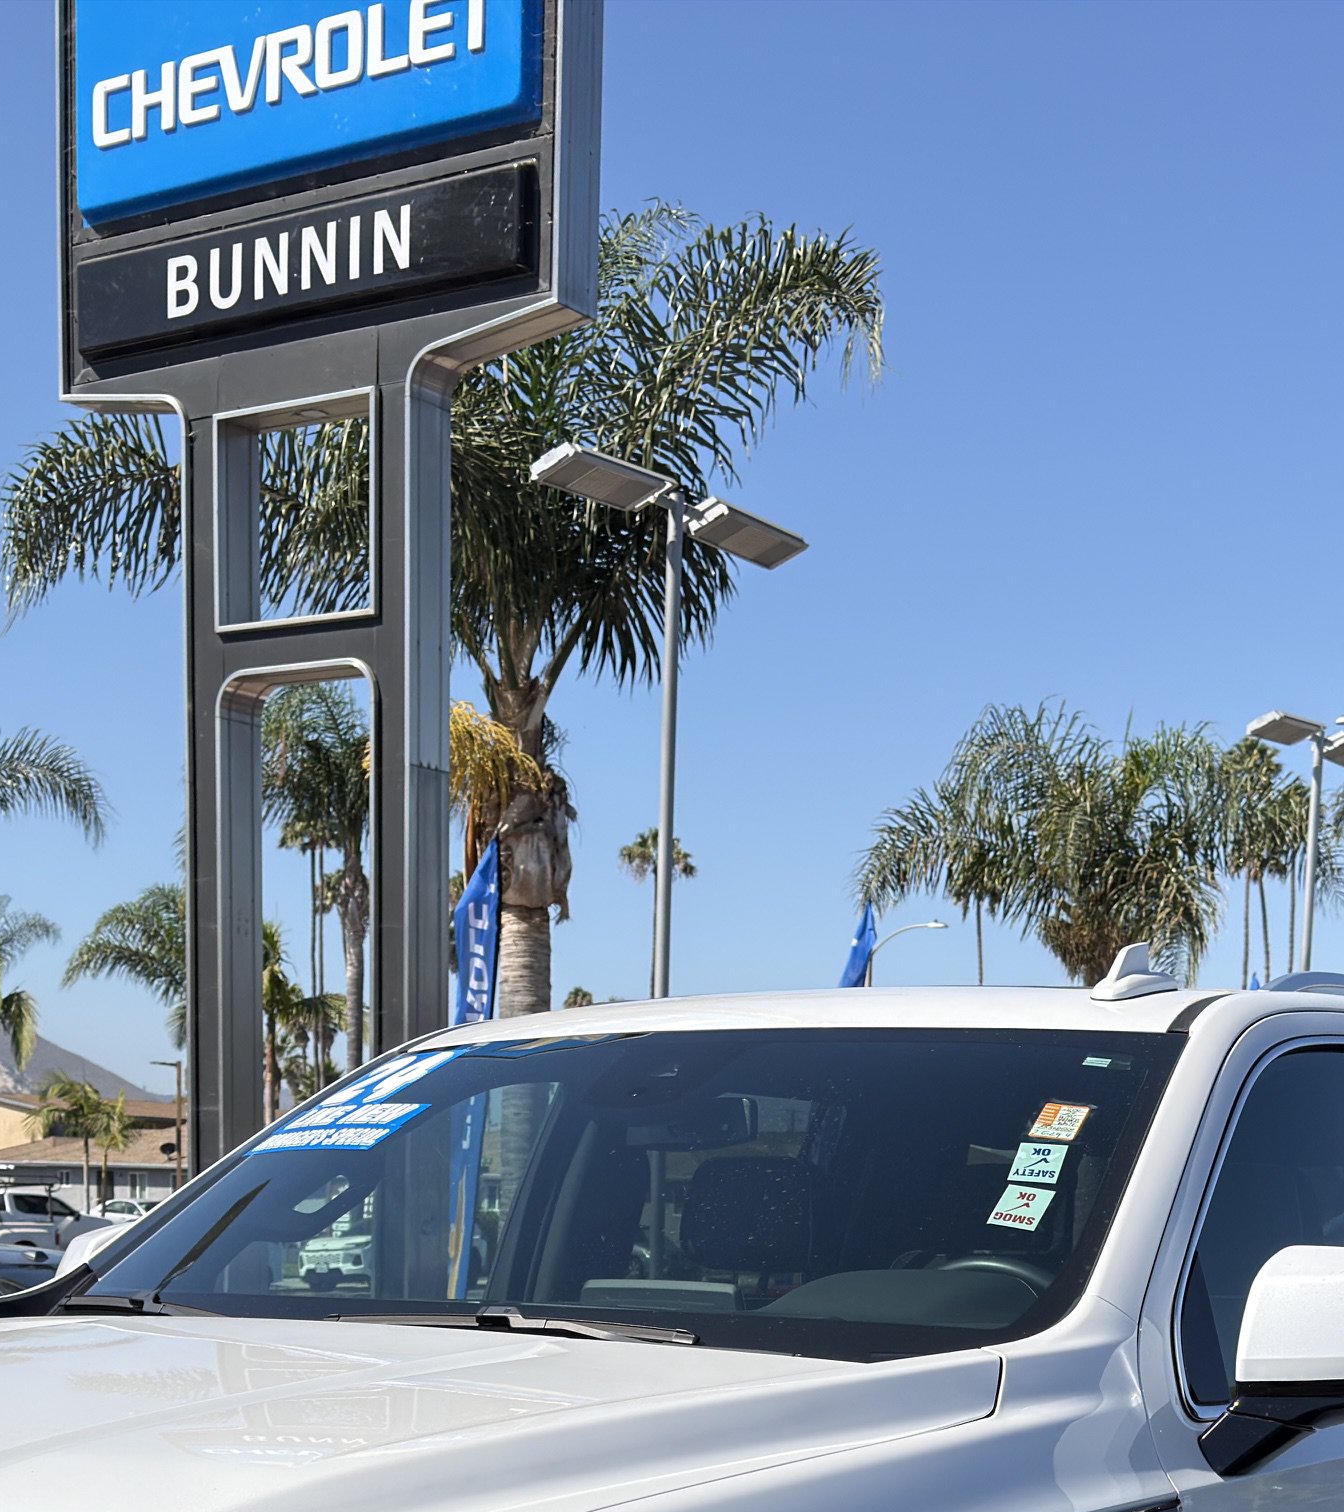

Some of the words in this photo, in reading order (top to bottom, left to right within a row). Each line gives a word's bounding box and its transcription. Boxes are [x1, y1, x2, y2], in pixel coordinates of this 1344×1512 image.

[166, 203, 412, 320] BUNNIN
[284, 1104, 358, 1131] LIKE
[336, 1103, 421, 1125] NEW
[329, 1127, 391, 1146] SPECIAL
[1032, 1147, 1052, 1157] OK
[1012, 1168, 1056, 1179] SAFETY
[1016, 1191, 1037, 1202] OK
[993, 1211, 1036, 1226] SMOG
